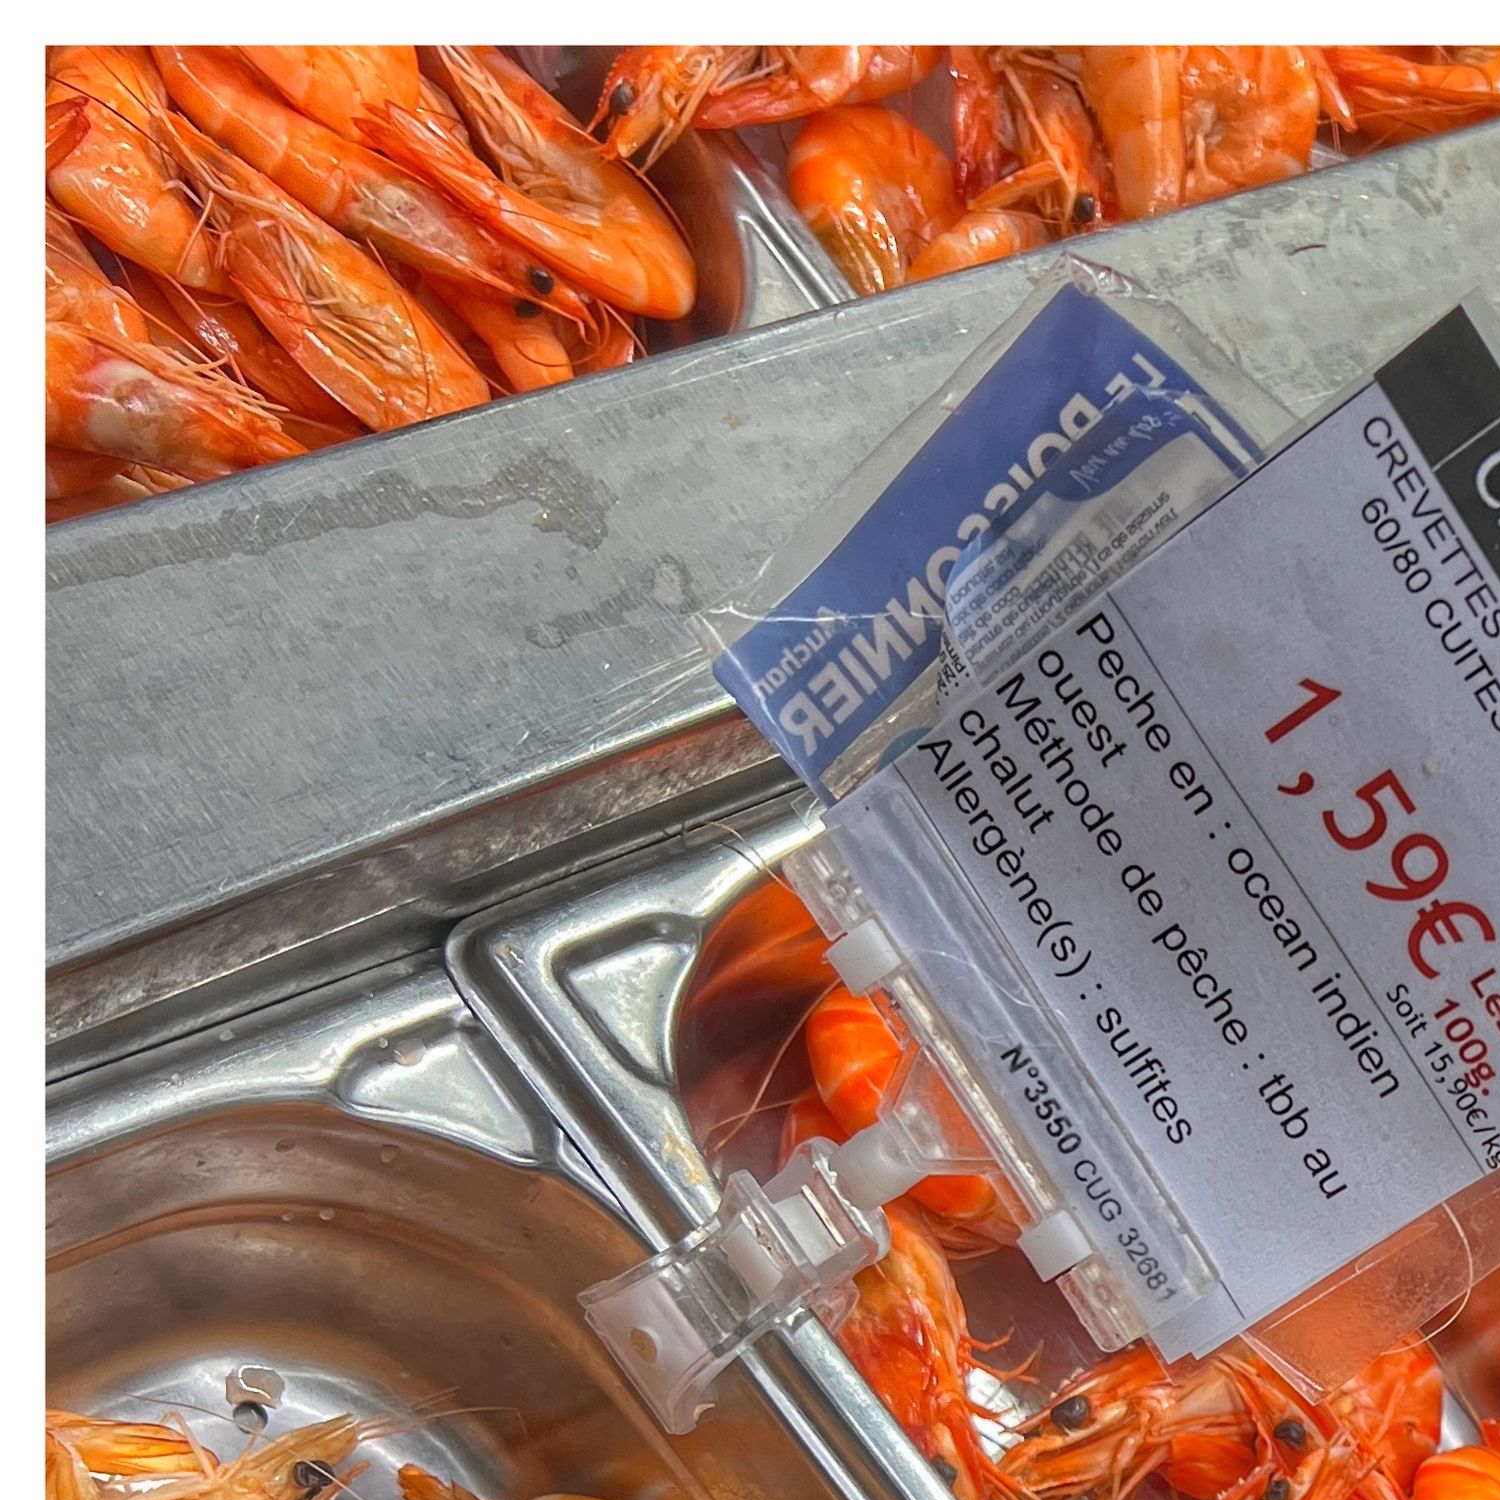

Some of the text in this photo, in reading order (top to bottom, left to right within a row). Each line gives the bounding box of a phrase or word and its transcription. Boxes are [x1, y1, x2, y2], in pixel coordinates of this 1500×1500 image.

[1361, 497, 1431, 593] 60/80
[959, 709, 1054, 834] chalut
[1037, 650, 1126, 767] ouest
[1075, 611, 1170, 752] Peche
[1169, 761, 1212, 815] en
[1227, 847, 1317, 971] ocean
[1311, 972, 1398, 1097] indien
[1264, 678, 1496, 979] 1,59€
[916, 739, 1091, 976] Allergène(s)
[1096, 1007, 1191, 1143] sulfites
[995, 672, 1122, 855] Méthode
[1121, 864, 1162, 916] de
[1151, 923, 1247, 1045] pêche
[1258, 1073, 1308, 1138] tbb
[1303, 1148, 1347, 1199] au
[1385, 983, 1427, 1038] Soit
[1434, 999, 1495, 1096] 100g.
[999, 1044, 1176, 1299] N°3550 CUG 32681
